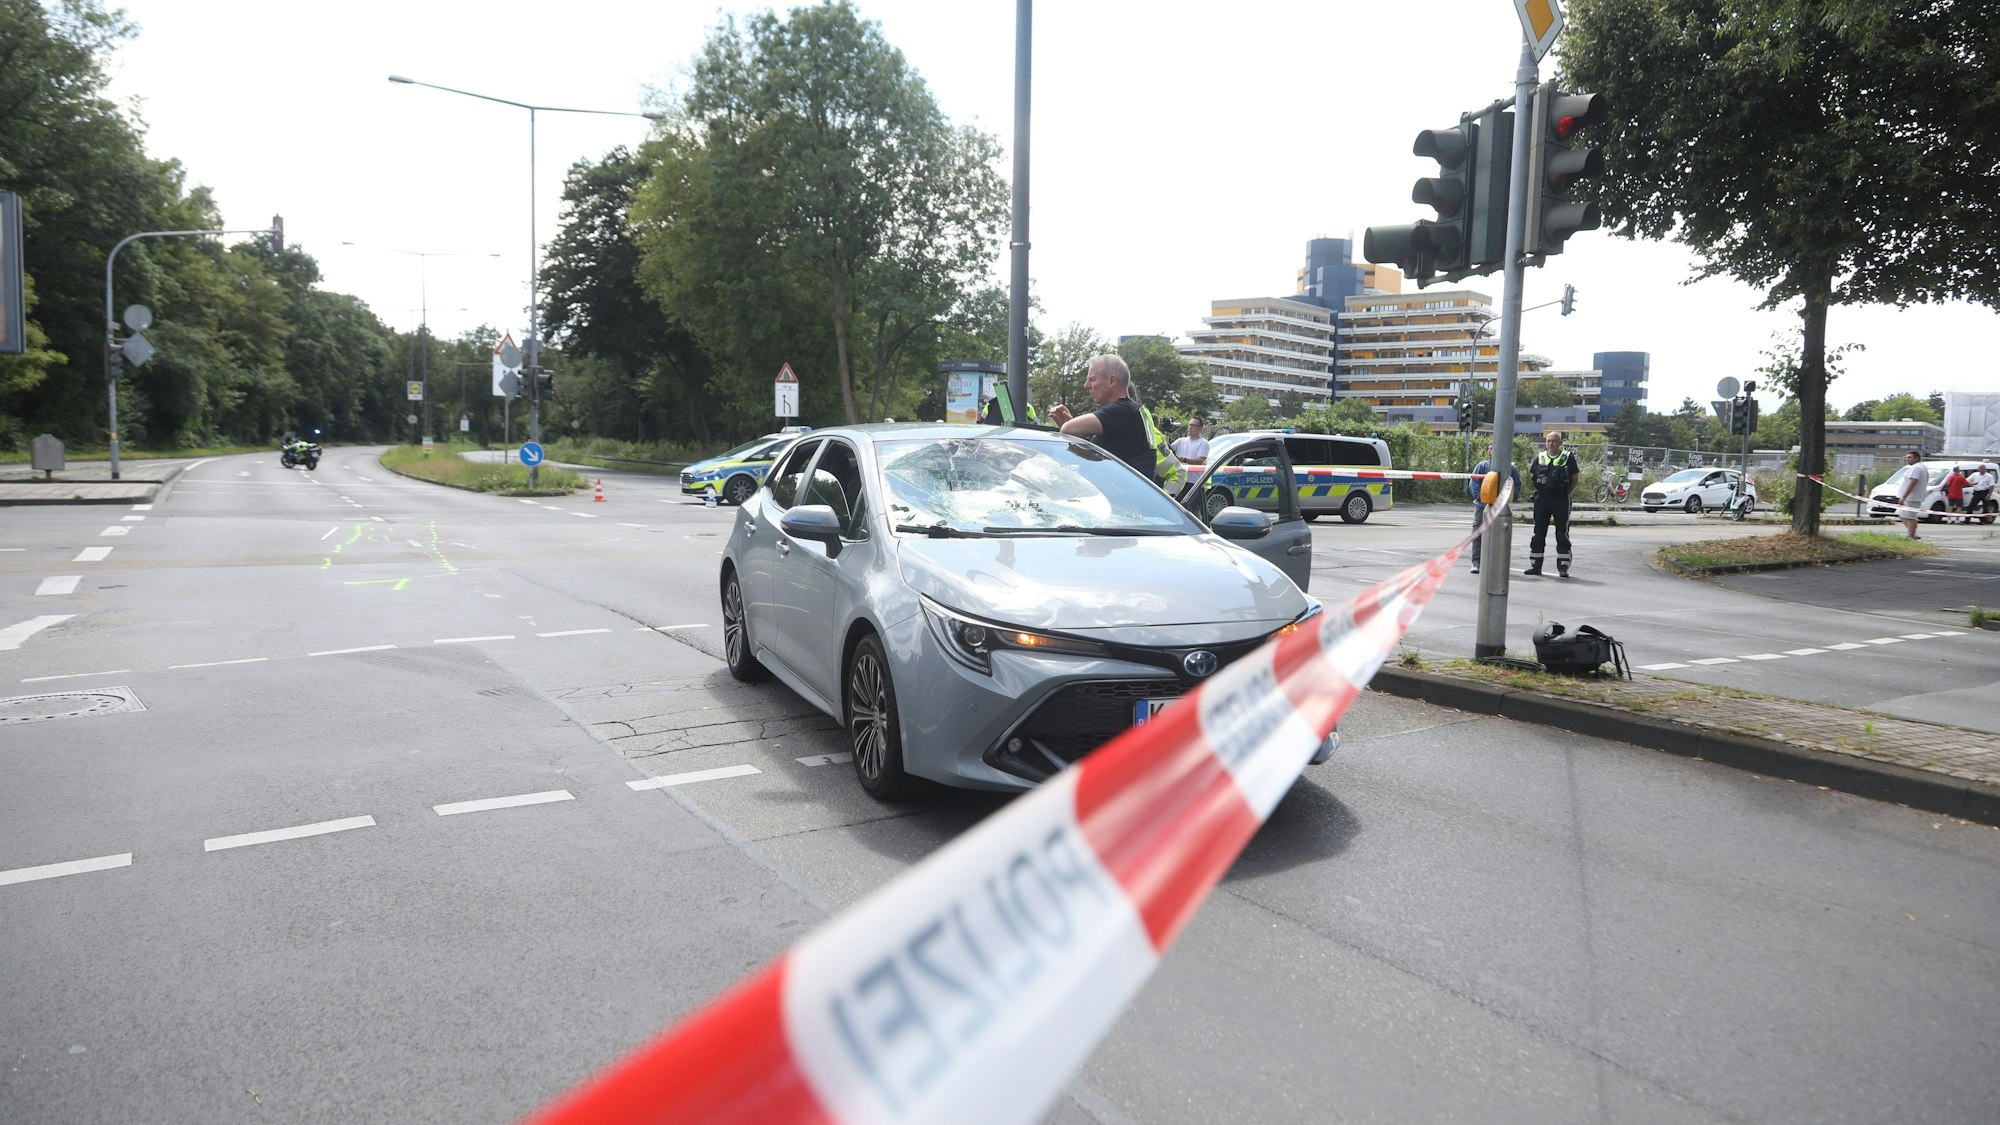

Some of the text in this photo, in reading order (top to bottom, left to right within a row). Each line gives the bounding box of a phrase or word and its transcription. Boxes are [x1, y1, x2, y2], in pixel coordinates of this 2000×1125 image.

[1629, 448, 1644, 457] Kings
[1629, 455, 1643, 464] Floyd
[1689, 453, 1703, 461] Kings
[1246, 476, 1274, 484] POLIZEI
